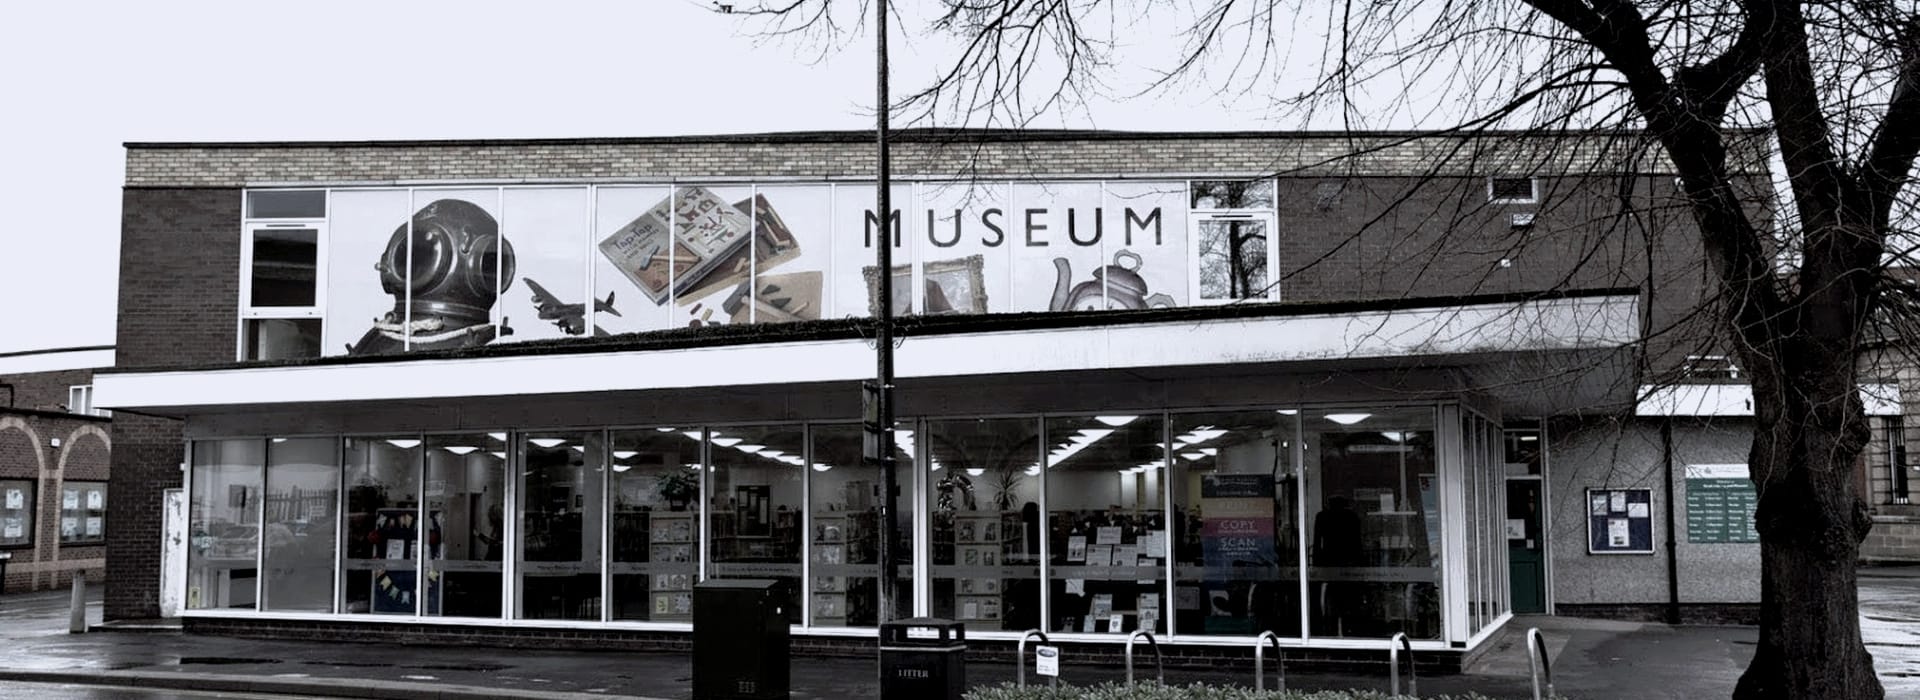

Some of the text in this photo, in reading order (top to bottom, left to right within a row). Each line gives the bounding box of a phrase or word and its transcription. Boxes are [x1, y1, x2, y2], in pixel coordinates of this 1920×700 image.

[864, 206, 1162, 248] MUSEUM
[1220, 519, 1256, 530] COPY
[1220, 537, 1256, 548] SCAN
[898, 668, 929, 679] LITTER
